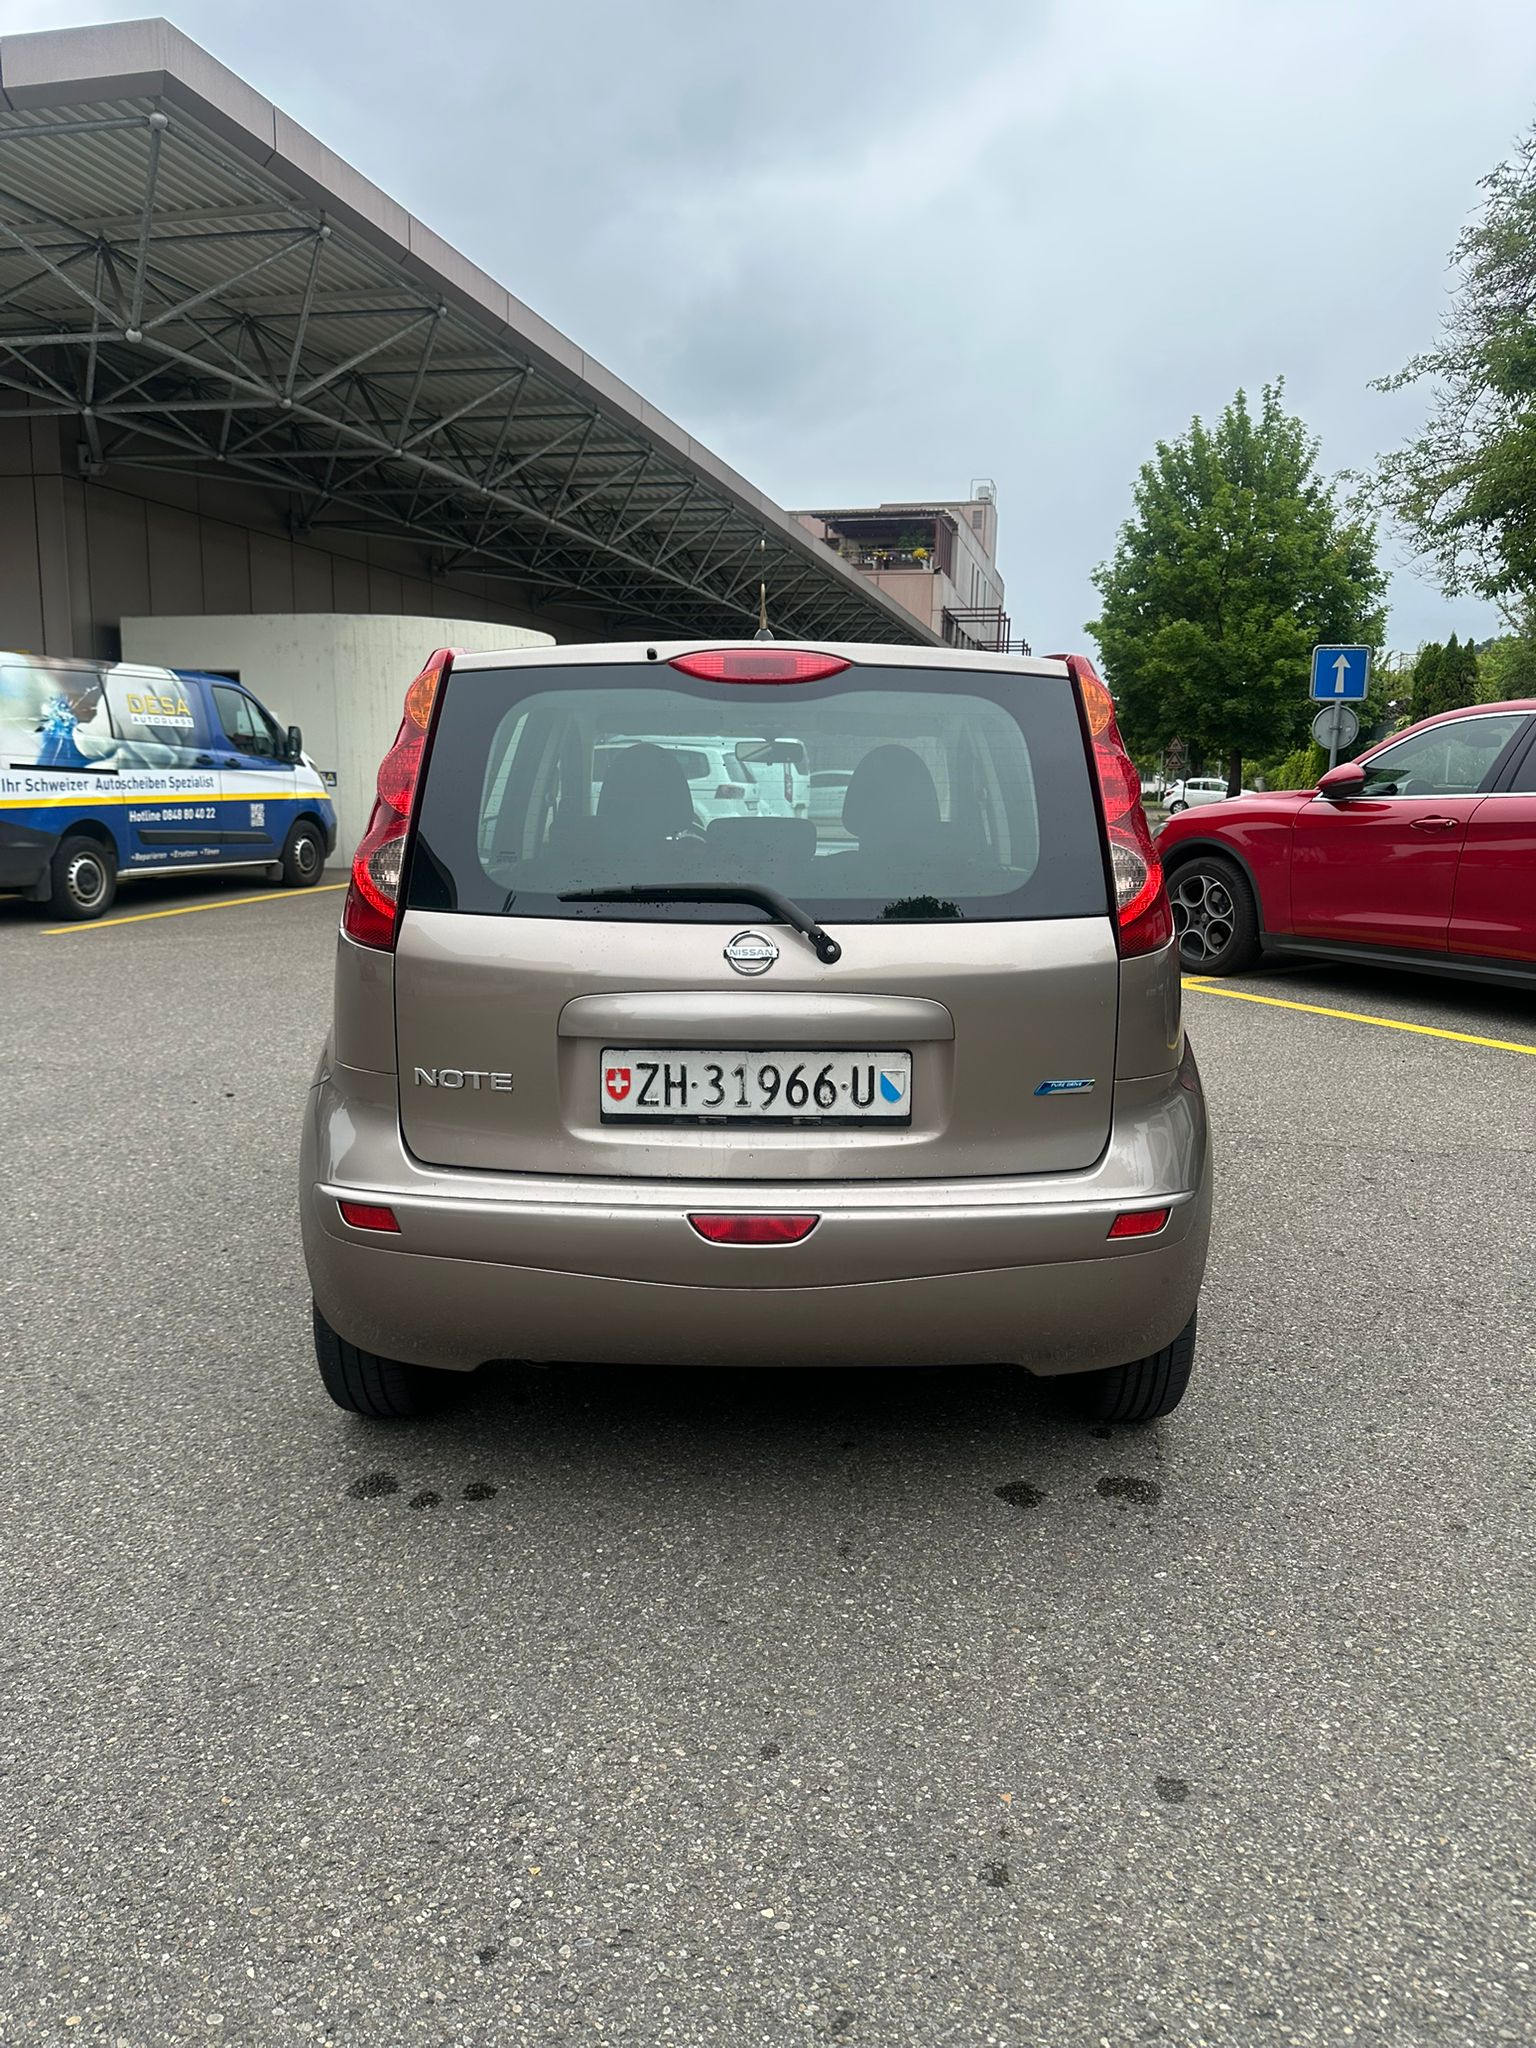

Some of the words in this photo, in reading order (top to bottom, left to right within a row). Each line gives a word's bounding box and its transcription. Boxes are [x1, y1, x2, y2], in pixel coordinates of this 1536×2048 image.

[127, 693, 192, 717] DESA
[133, 715, 194, 726] AUTOGLASS
[1, 777, 22, 793] Ihr
[25, 777, 90, 793] Schweizer
[96, 776, 167, 791] Autoscheiben
[168, 775, 214, 792] Spezialist
[128, 809, 161, 823] Hotline
[195, 807, 205, 820] 40
[206, 806, 216, 819] 22
[729, 948, 774, 957] NISSAN
[413, 1066, 514, 1092] NOTE
